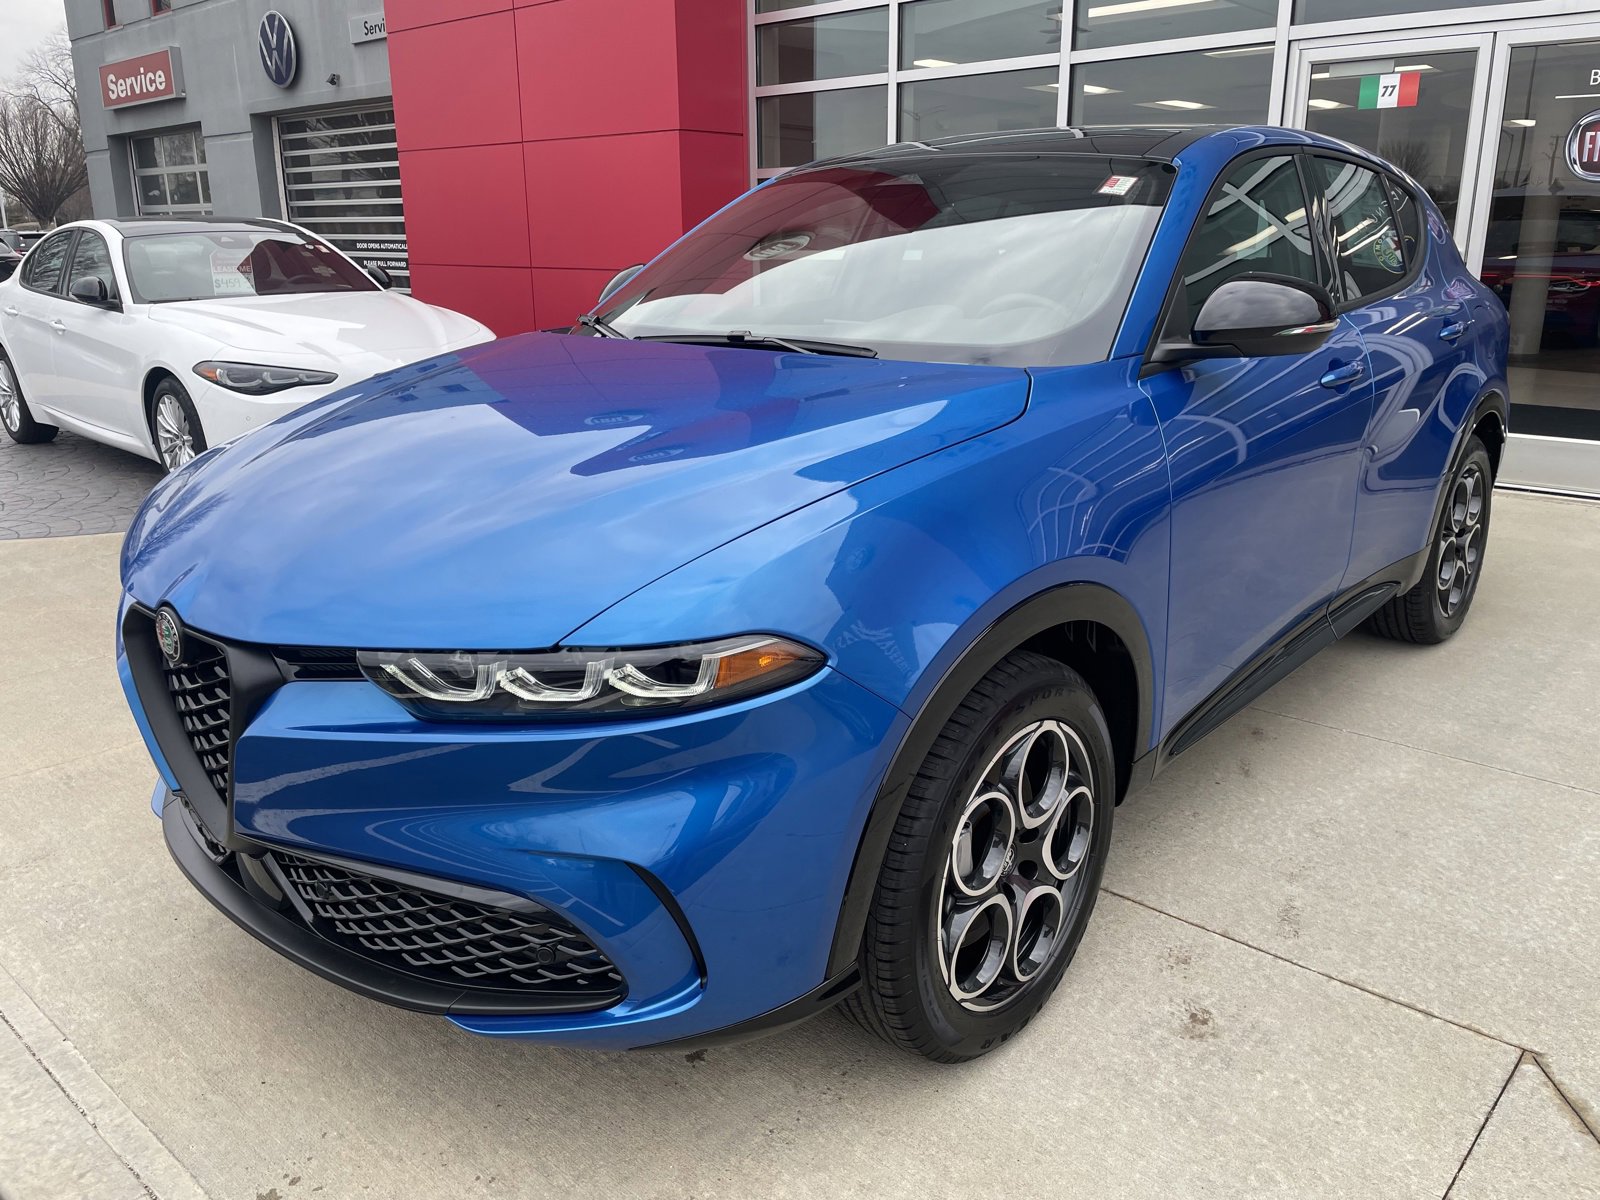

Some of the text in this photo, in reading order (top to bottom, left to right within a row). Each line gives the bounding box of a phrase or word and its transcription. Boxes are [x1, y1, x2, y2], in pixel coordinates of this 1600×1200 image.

[363, 17, 386, 36] Servi
[107, 67, 166, 100] Service
[1381, 85, 1397, 97] 77
[214, 277, 241, 289] $459
